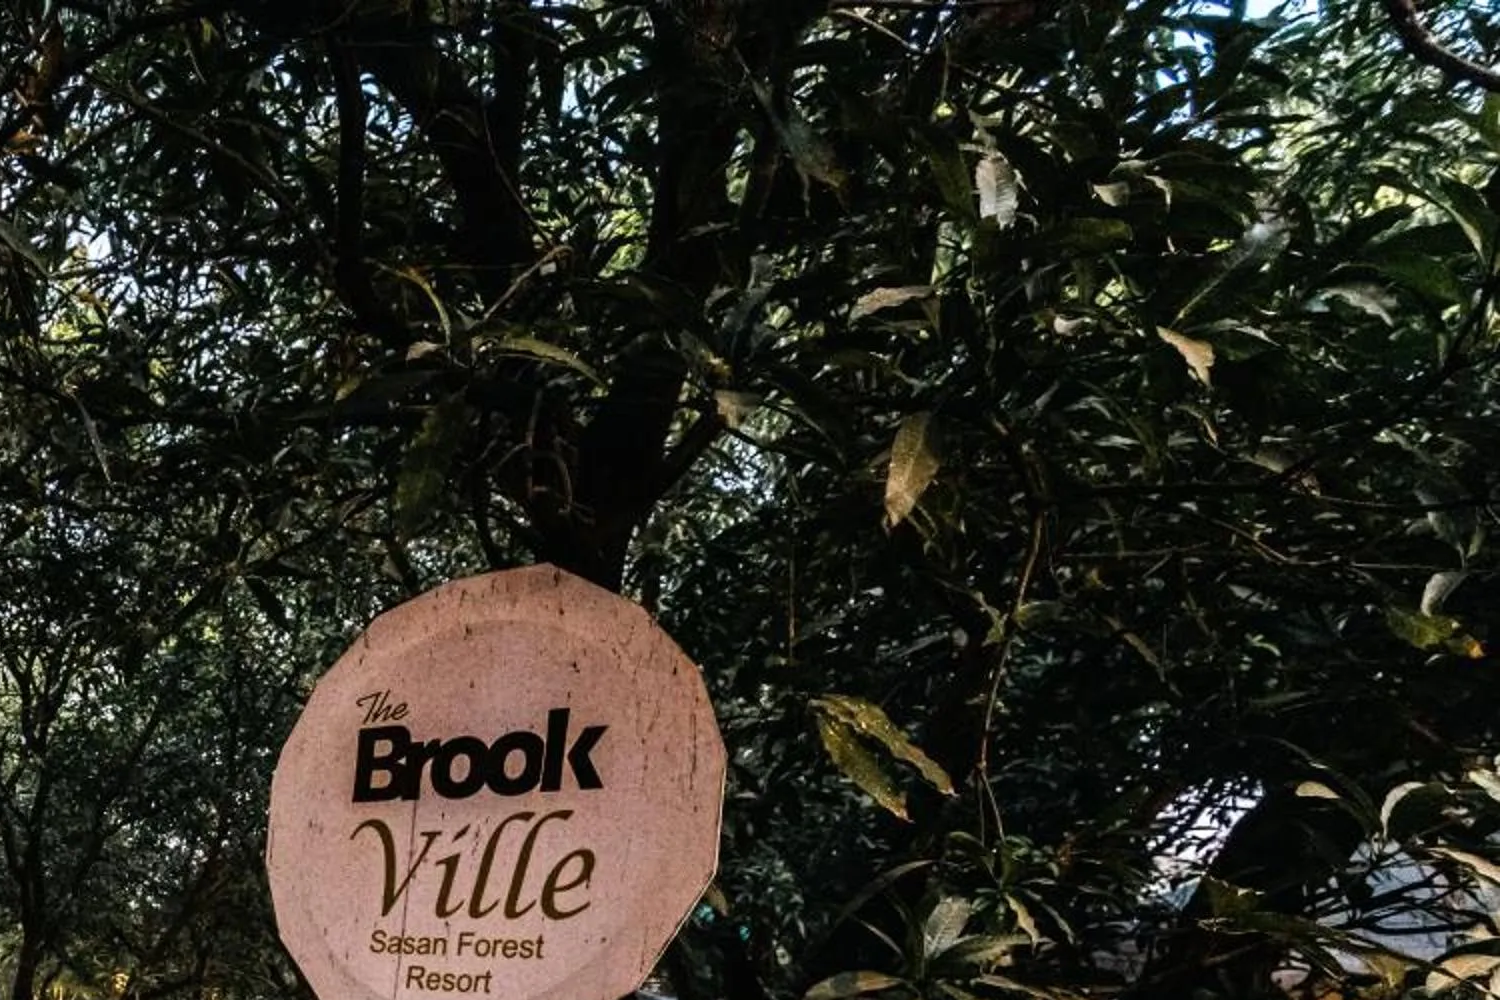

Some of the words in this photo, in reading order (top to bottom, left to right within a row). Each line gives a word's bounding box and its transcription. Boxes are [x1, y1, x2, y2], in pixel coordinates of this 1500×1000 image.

[356, 690, 409, 723] The
[351, 707, 610, 802] Brook
[350, 810, 597, 921] Ville
[369, 929, 448, 957] Sasan
[457, 931, 545, 960] Forest
[405, 965, 493, 995] Resort
